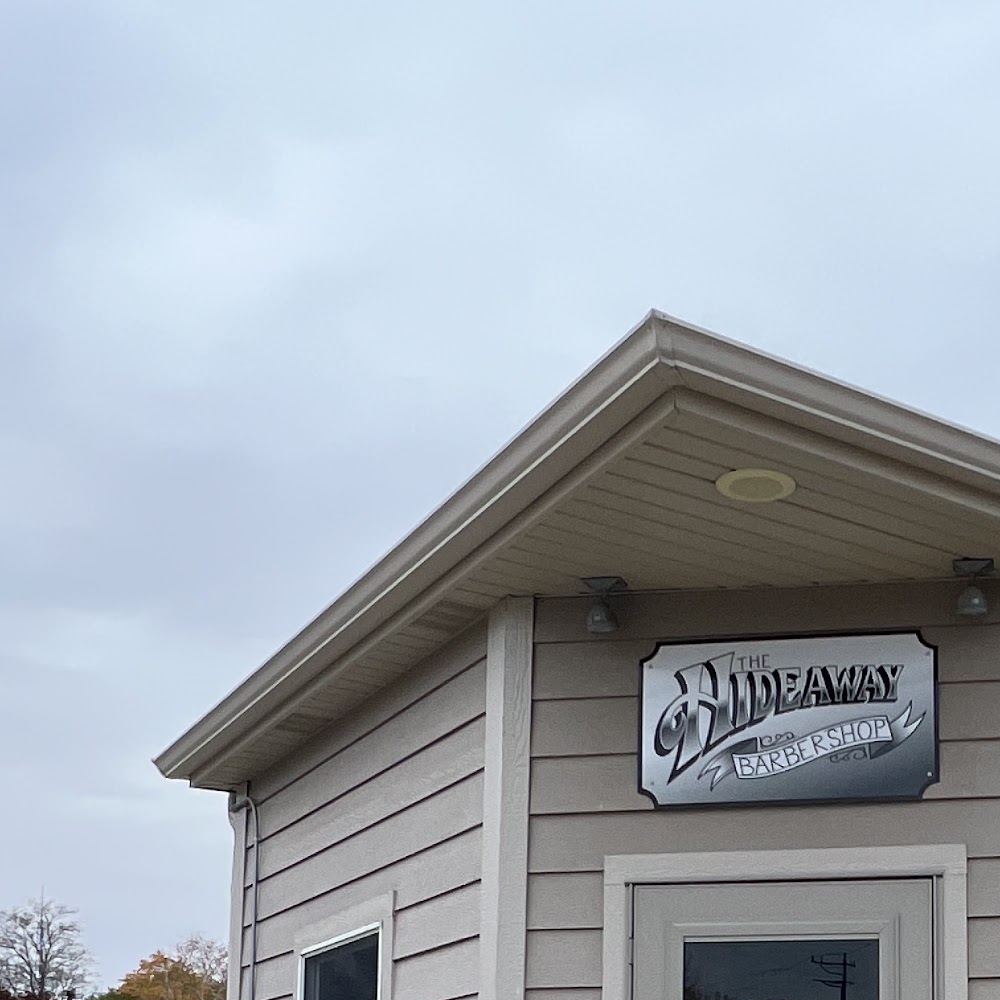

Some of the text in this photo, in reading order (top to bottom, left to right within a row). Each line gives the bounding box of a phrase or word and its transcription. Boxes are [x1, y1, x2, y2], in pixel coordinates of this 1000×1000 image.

[736, 654, 770, 669] THE
[654, 651, 905, 785] HIDEAWAY
[738, 718, 887, 777] BARBERSHOP
